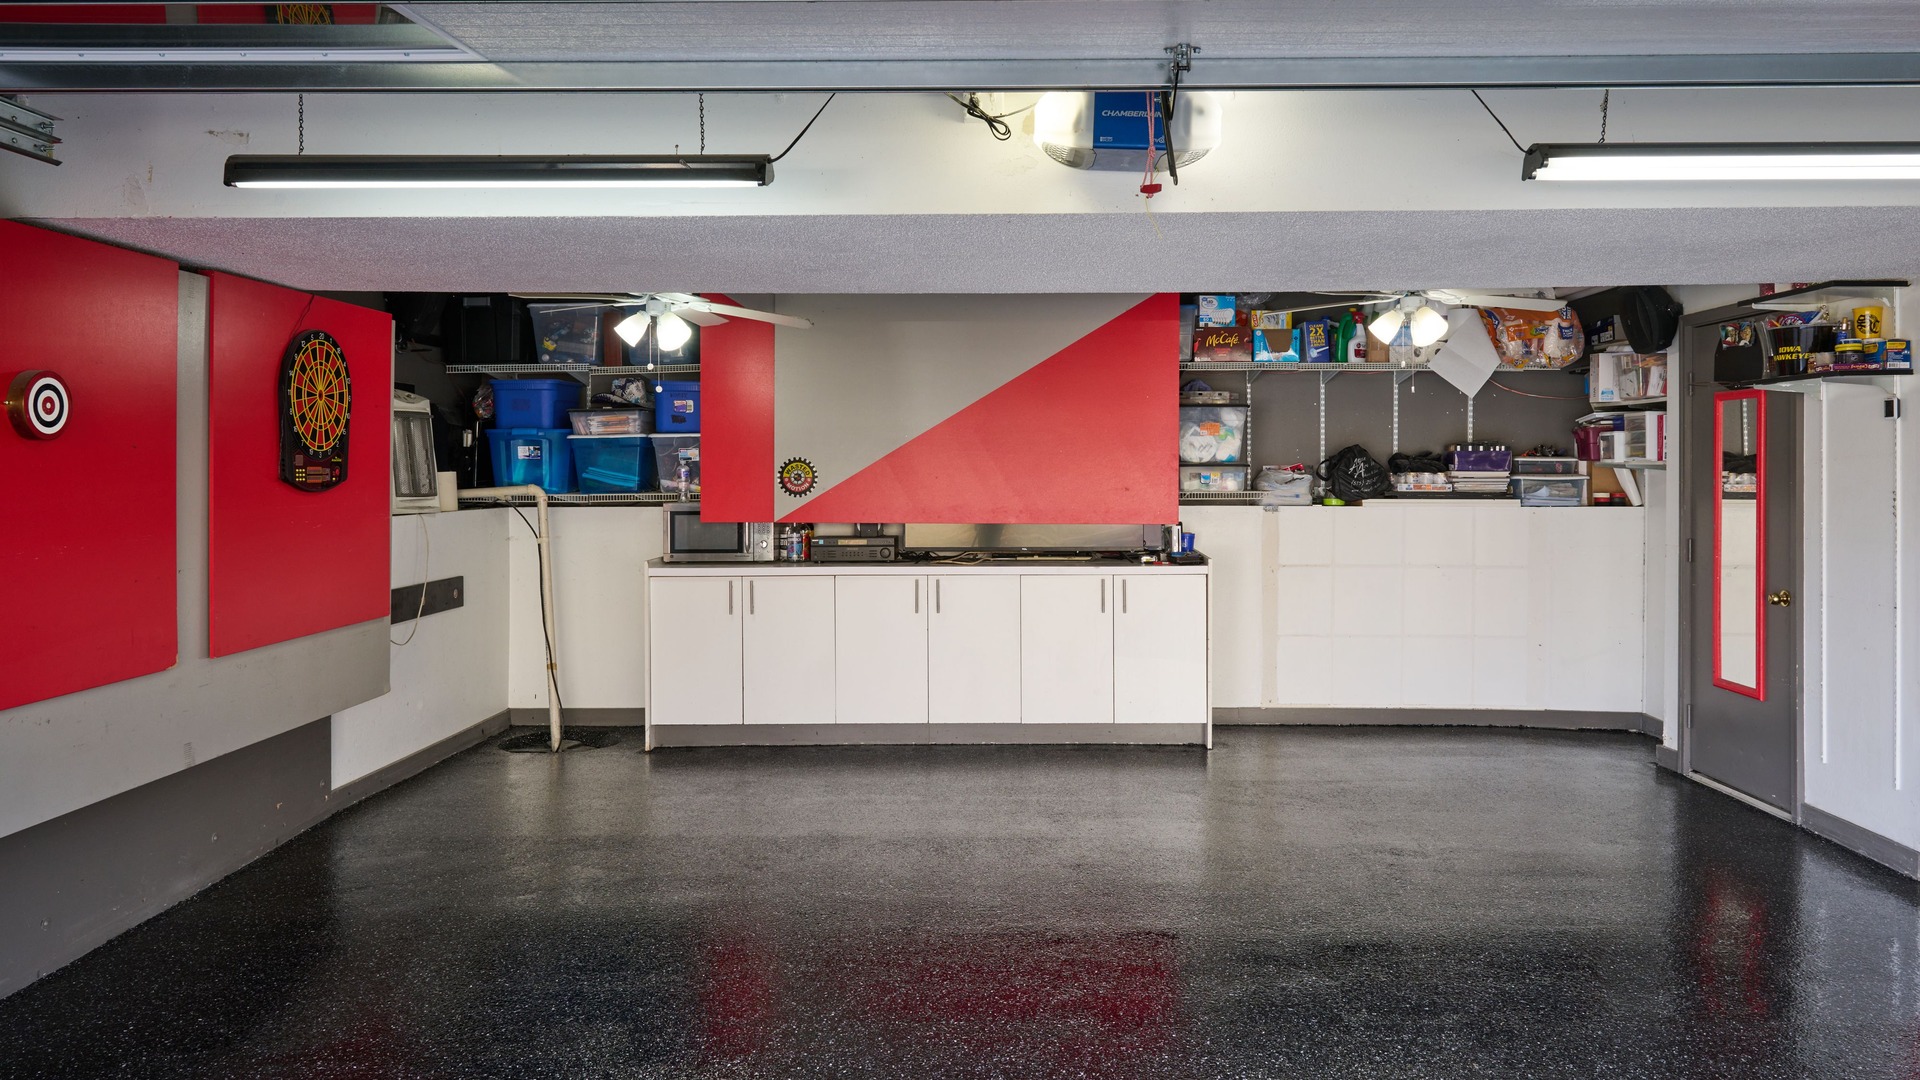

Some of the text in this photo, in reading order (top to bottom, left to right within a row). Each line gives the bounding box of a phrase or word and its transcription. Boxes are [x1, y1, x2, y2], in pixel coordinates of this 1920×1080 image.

[1101, 110, 1162, 118] CHAMBERLIN
[1778, 345, 1801, 353] IOWA
[785, 464, 811, 475] WASTED
[786, 483, 809, 491] MOTION
